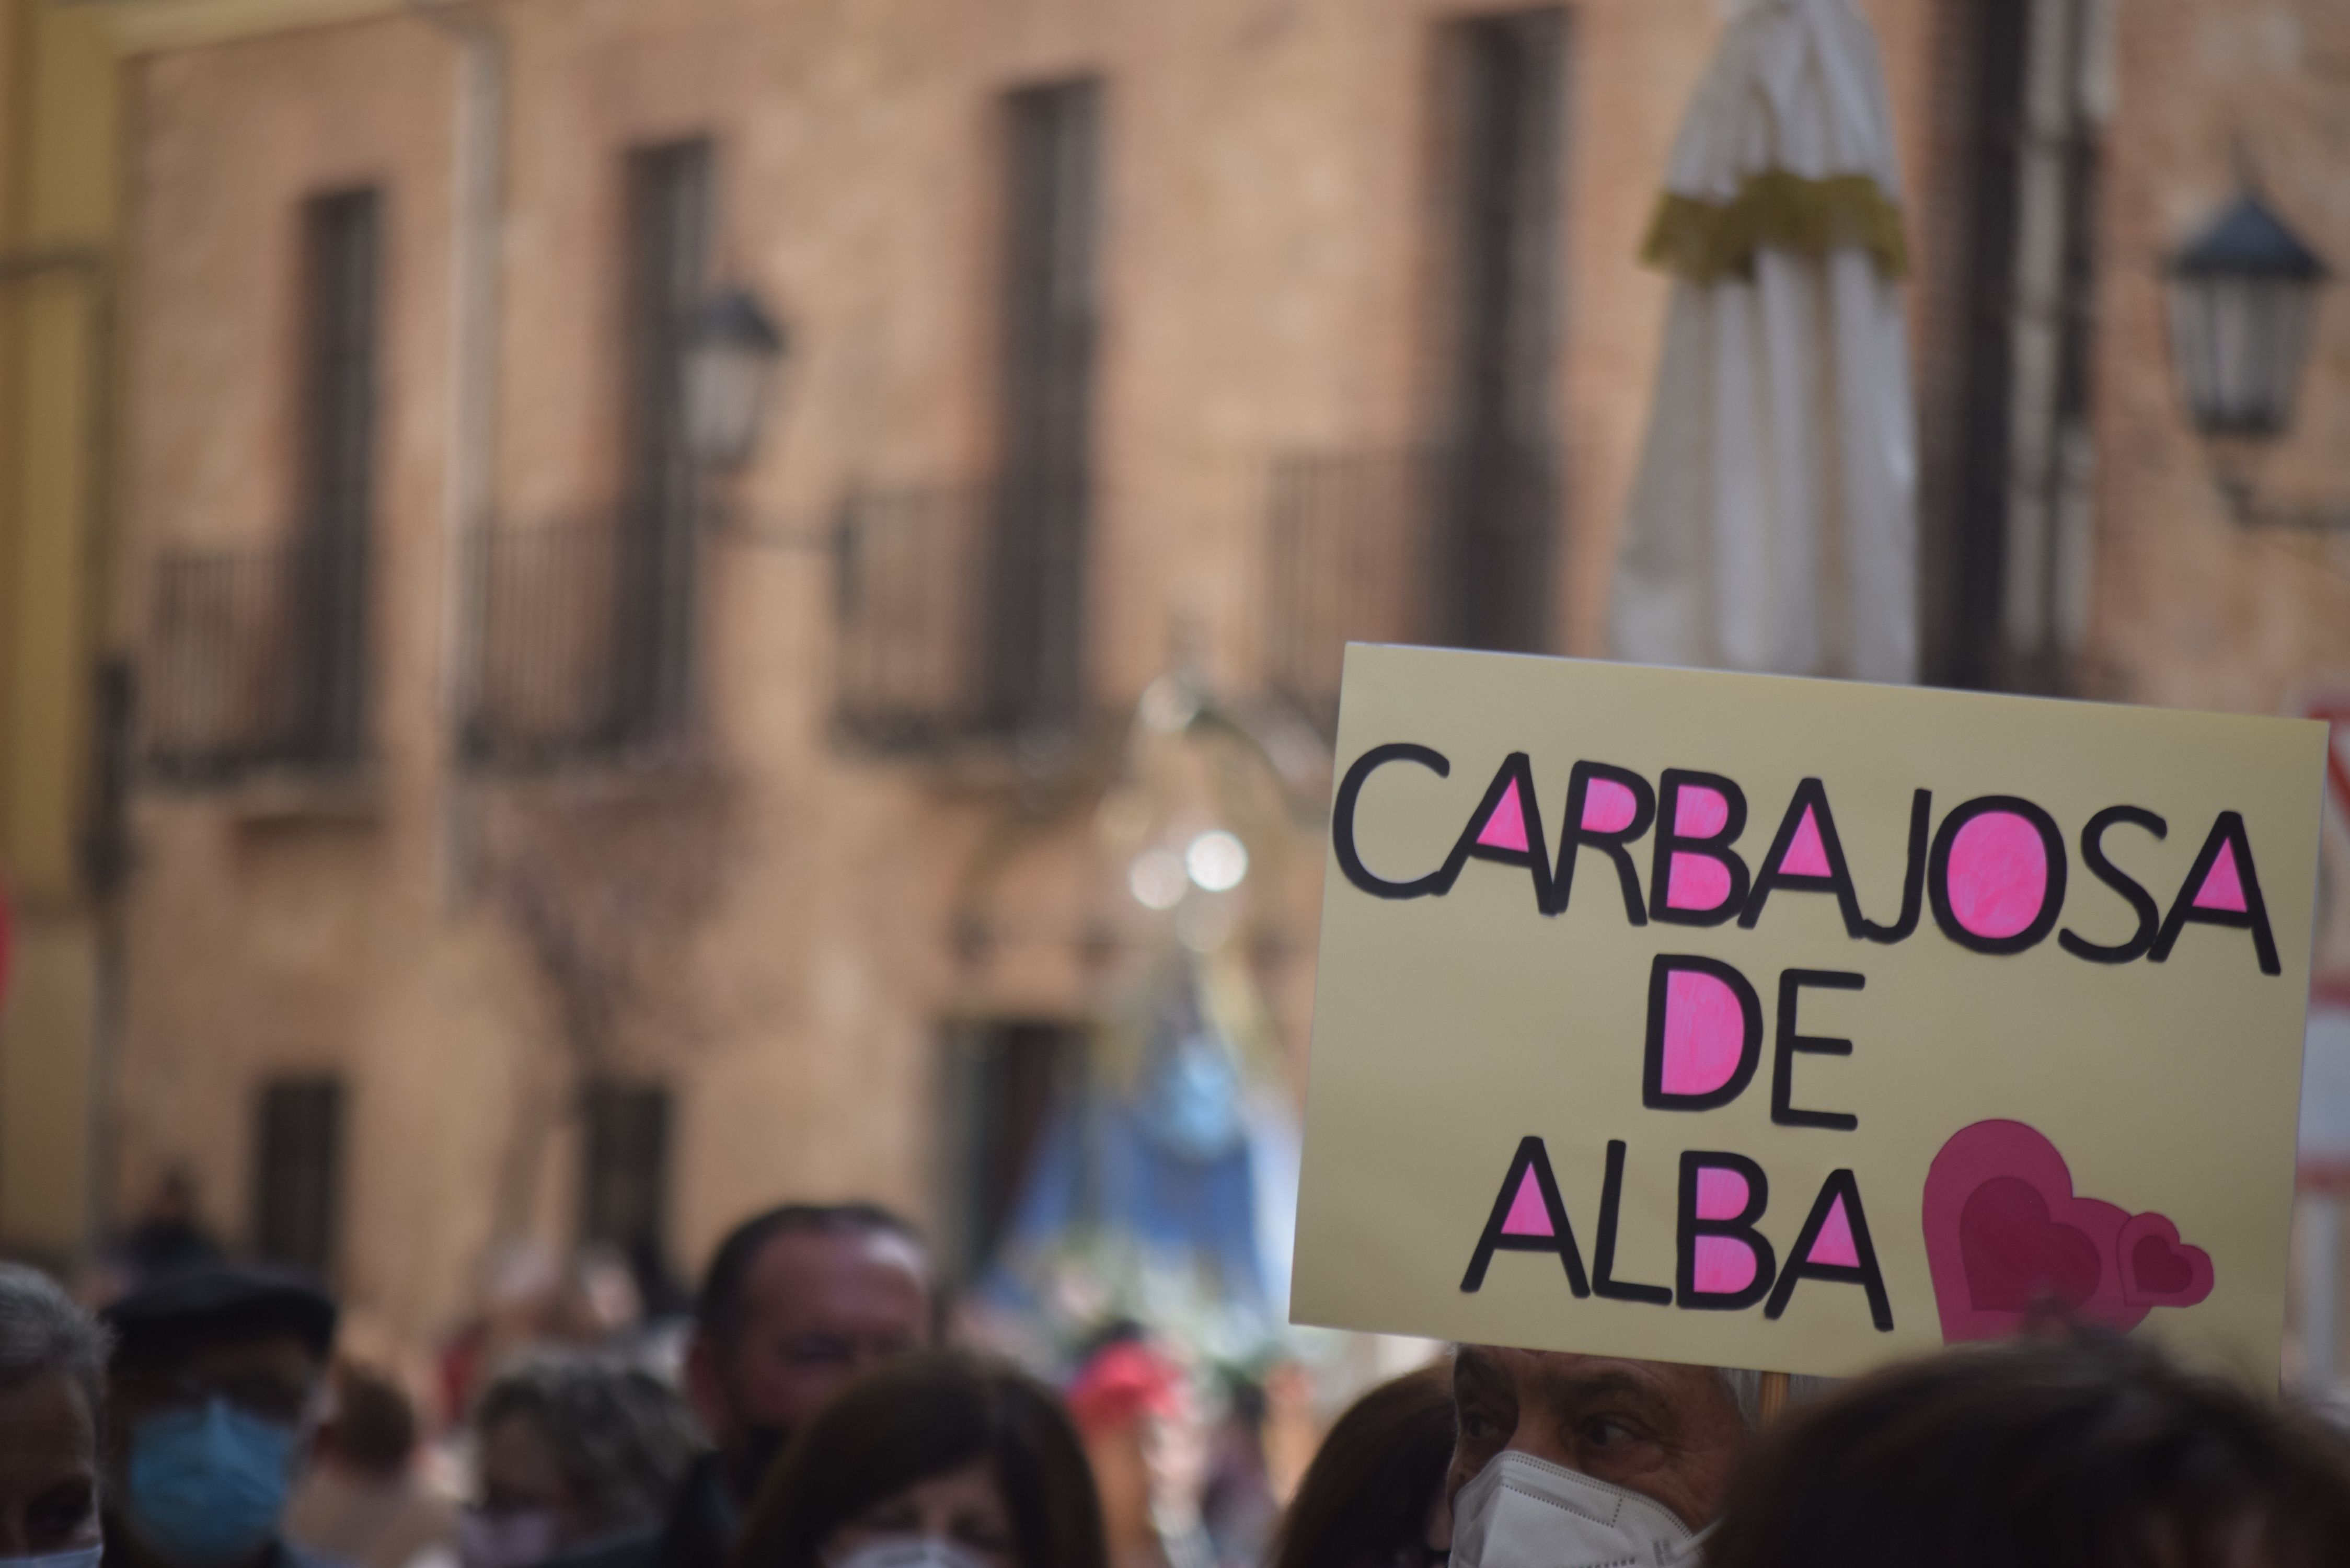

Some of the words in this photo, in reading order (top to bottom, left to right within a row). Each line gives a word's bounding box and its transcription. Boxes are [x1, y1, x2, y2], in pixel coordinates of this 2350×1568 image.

[1332, 743, 2282, 976] CARBAJOSA
[1642, 953, 1867, 1132] DE
[1460, 1136, 1895, 1332] ALBA
